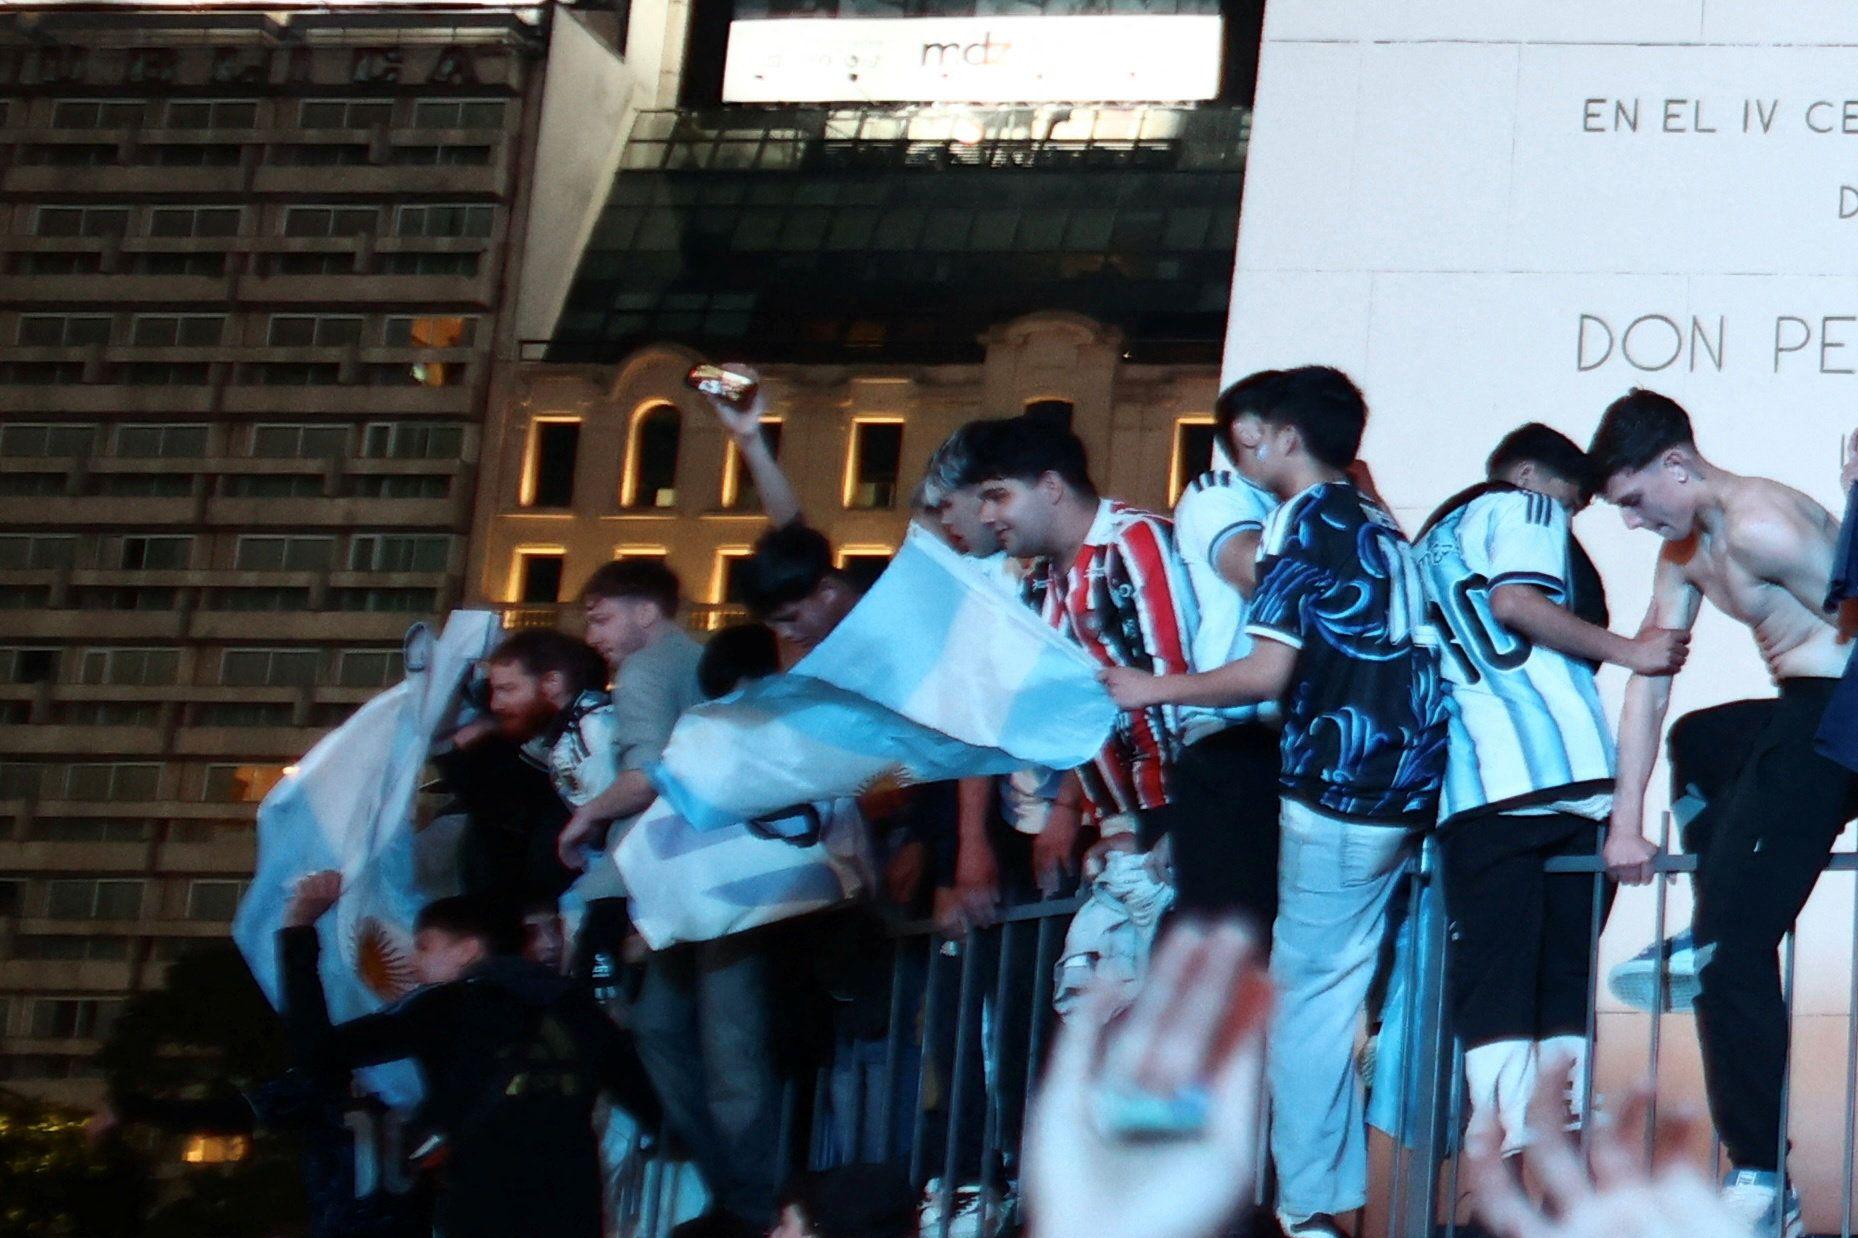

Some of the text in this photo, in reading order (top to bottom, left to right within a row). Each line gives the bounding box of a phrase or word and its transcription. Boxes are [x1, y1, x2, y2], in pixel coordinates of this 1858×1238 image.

[1582, 98, 1640, 134] EN
[1661, 98, 1718, 134] EL
[1742, 98, 1779, 135] IV
[1576, 312, 1725, 373] DON
[1425, 572, 1533, 686] 10
